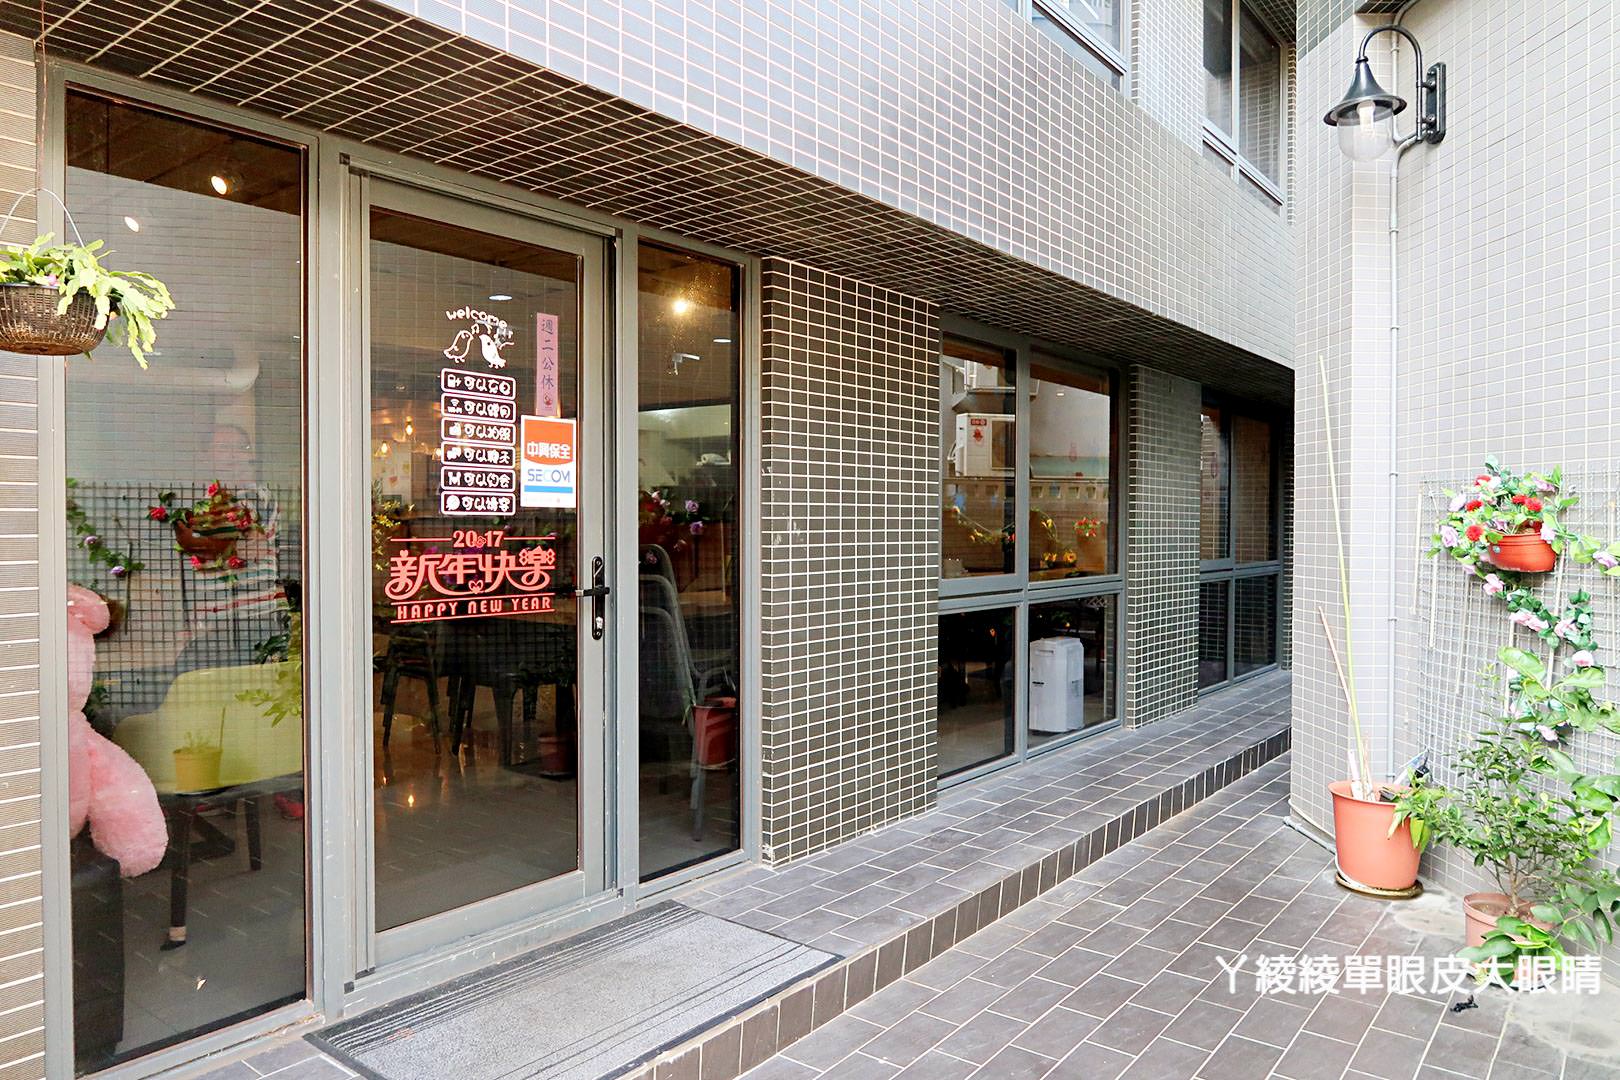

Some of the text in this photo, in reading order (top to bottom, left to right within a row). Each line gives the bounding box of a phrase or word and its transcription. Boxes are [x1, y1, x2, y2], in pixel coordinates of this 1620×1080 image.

[446, 306, 508, 328] welcome
[541, 319, 554, 391] 週二公休
[527, 468, 571, 483] SECOM
[453, 530, 504, 548] 2017
[384, 545, 556, 600] 新年快樂
[397, 596, 551, 620] HAPPY NEW YEAR
